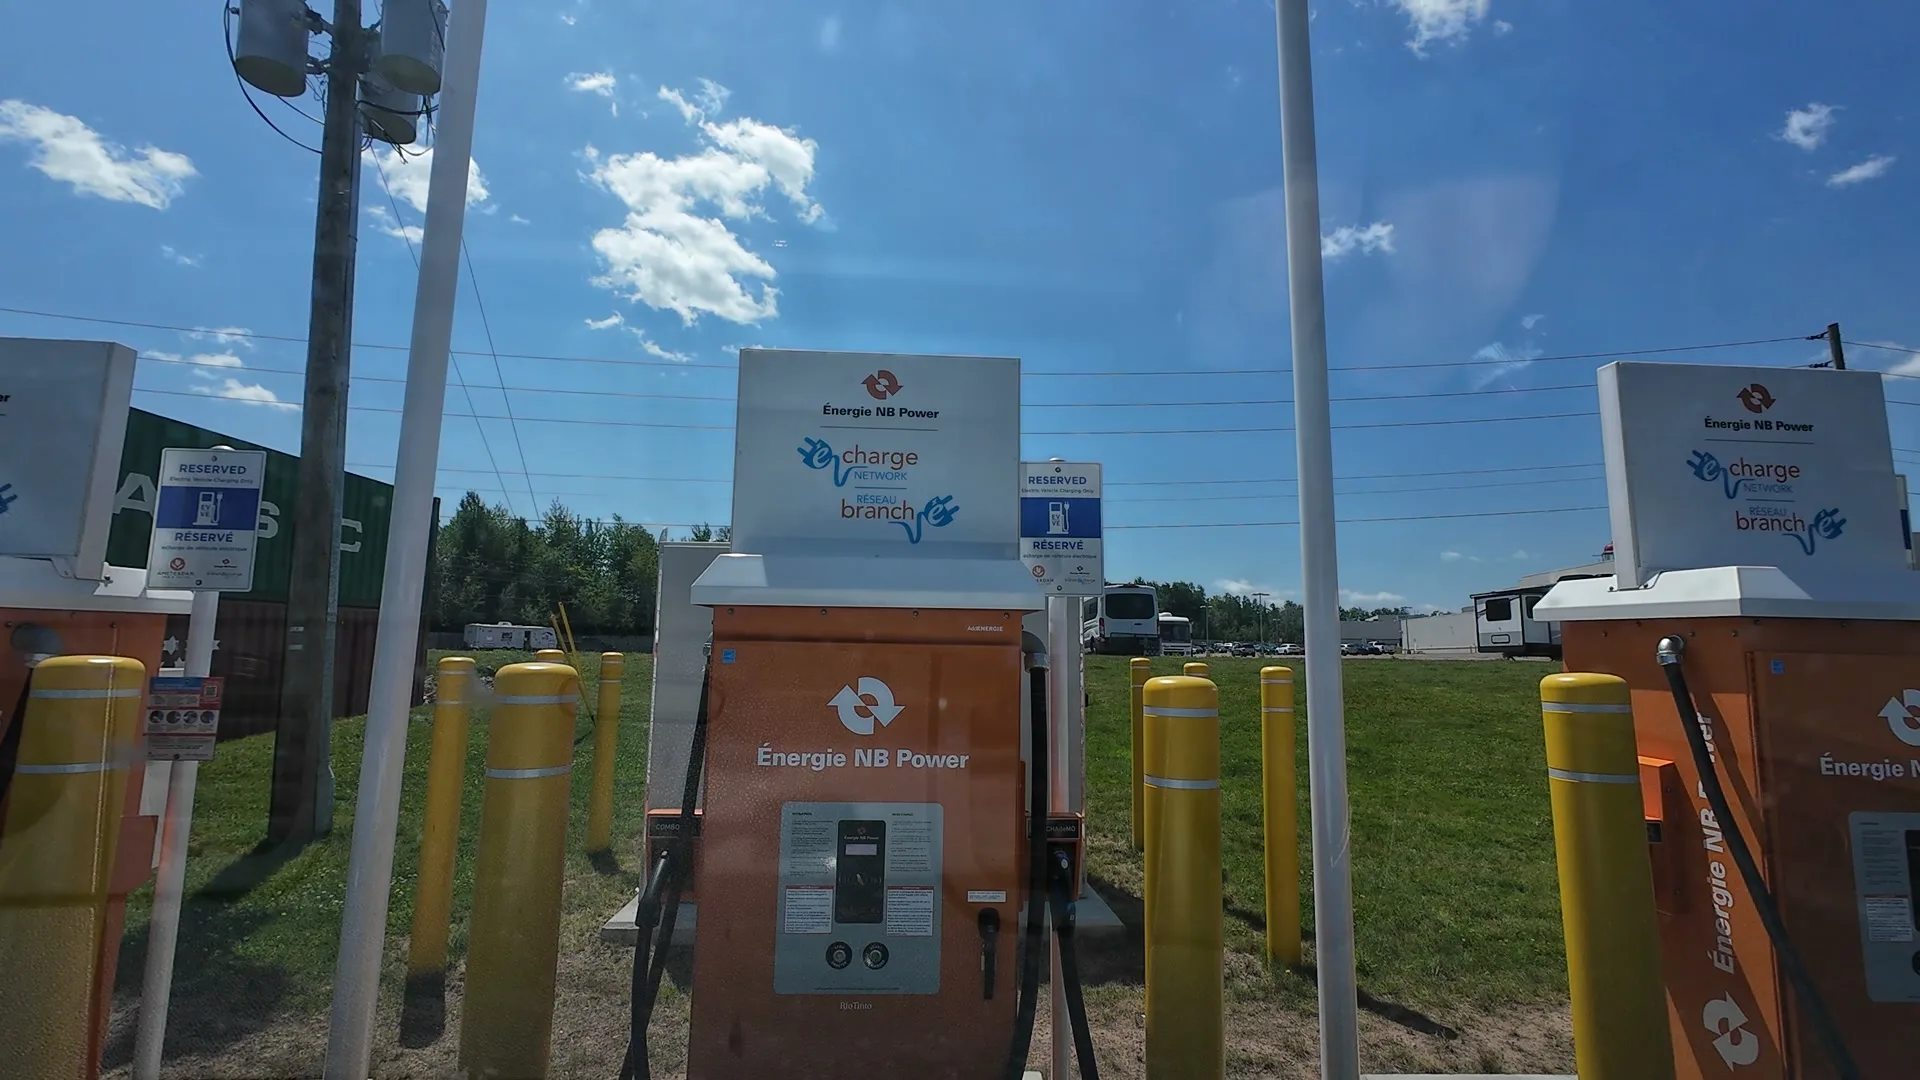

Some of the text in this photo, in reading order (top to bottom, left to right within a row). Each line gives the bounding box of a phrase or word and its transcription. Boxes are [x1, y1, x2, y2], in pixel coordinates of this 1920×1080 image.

[822, 402, 940, 419] Énergie NB Power
[1704, 415, 1814, 432] Énergie NB Power
[179, 464, 247, 475] RESERVED
[854, 471, 908, 480] NETWORK
[1028, 476, 1087, 485] RESERVED
[1743, 483, 1794, 493] NETWORK
[856, 493, 897, 504] RÉSEAU
[1749, 505, 1787, 517] RÉSEAU
[175, 530, 234, 543] RÉSERVÉ
[1033, 539, 1084, 550] RÉSERVÉ
[757, 742, 970, 771] Énergie NB Power
[1820, 751, 1905, 781] Énergie
[655, 823, 680, 831] COMBO
[1706, 861, 1735, 975] Énergie
